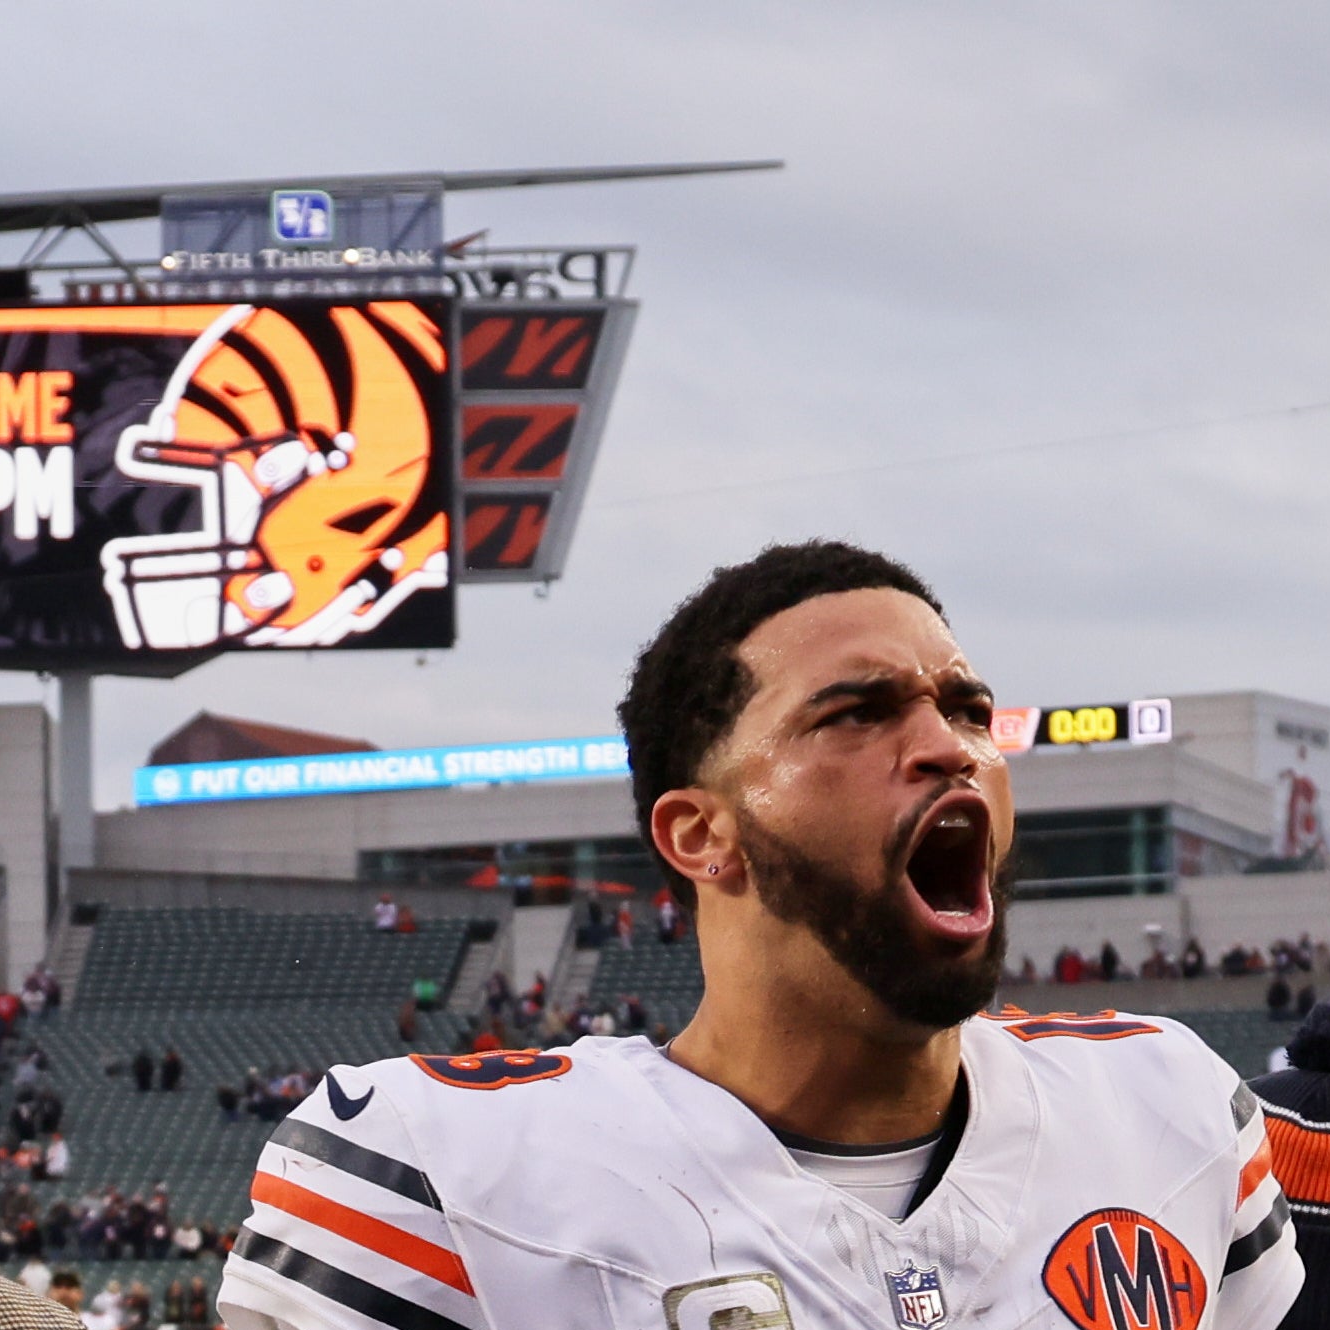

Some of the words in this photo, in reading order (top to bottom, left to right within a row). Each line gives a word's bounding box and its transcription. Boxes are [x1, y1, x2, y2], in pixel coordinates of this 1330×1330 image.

[173, 250, 251, 270] FIFTH
[358, 247, 435, 269] BANK
[1049, 707, 1117, 744] 0:00
[191, 766, 240, 795] PUT
[244, 763, 300, 793] OUR
[303, 755, 438, 786] FINANCIAL
[443, 745, 579, 779] STRENGTH
[901, 1294, 941, 1324] NFL
